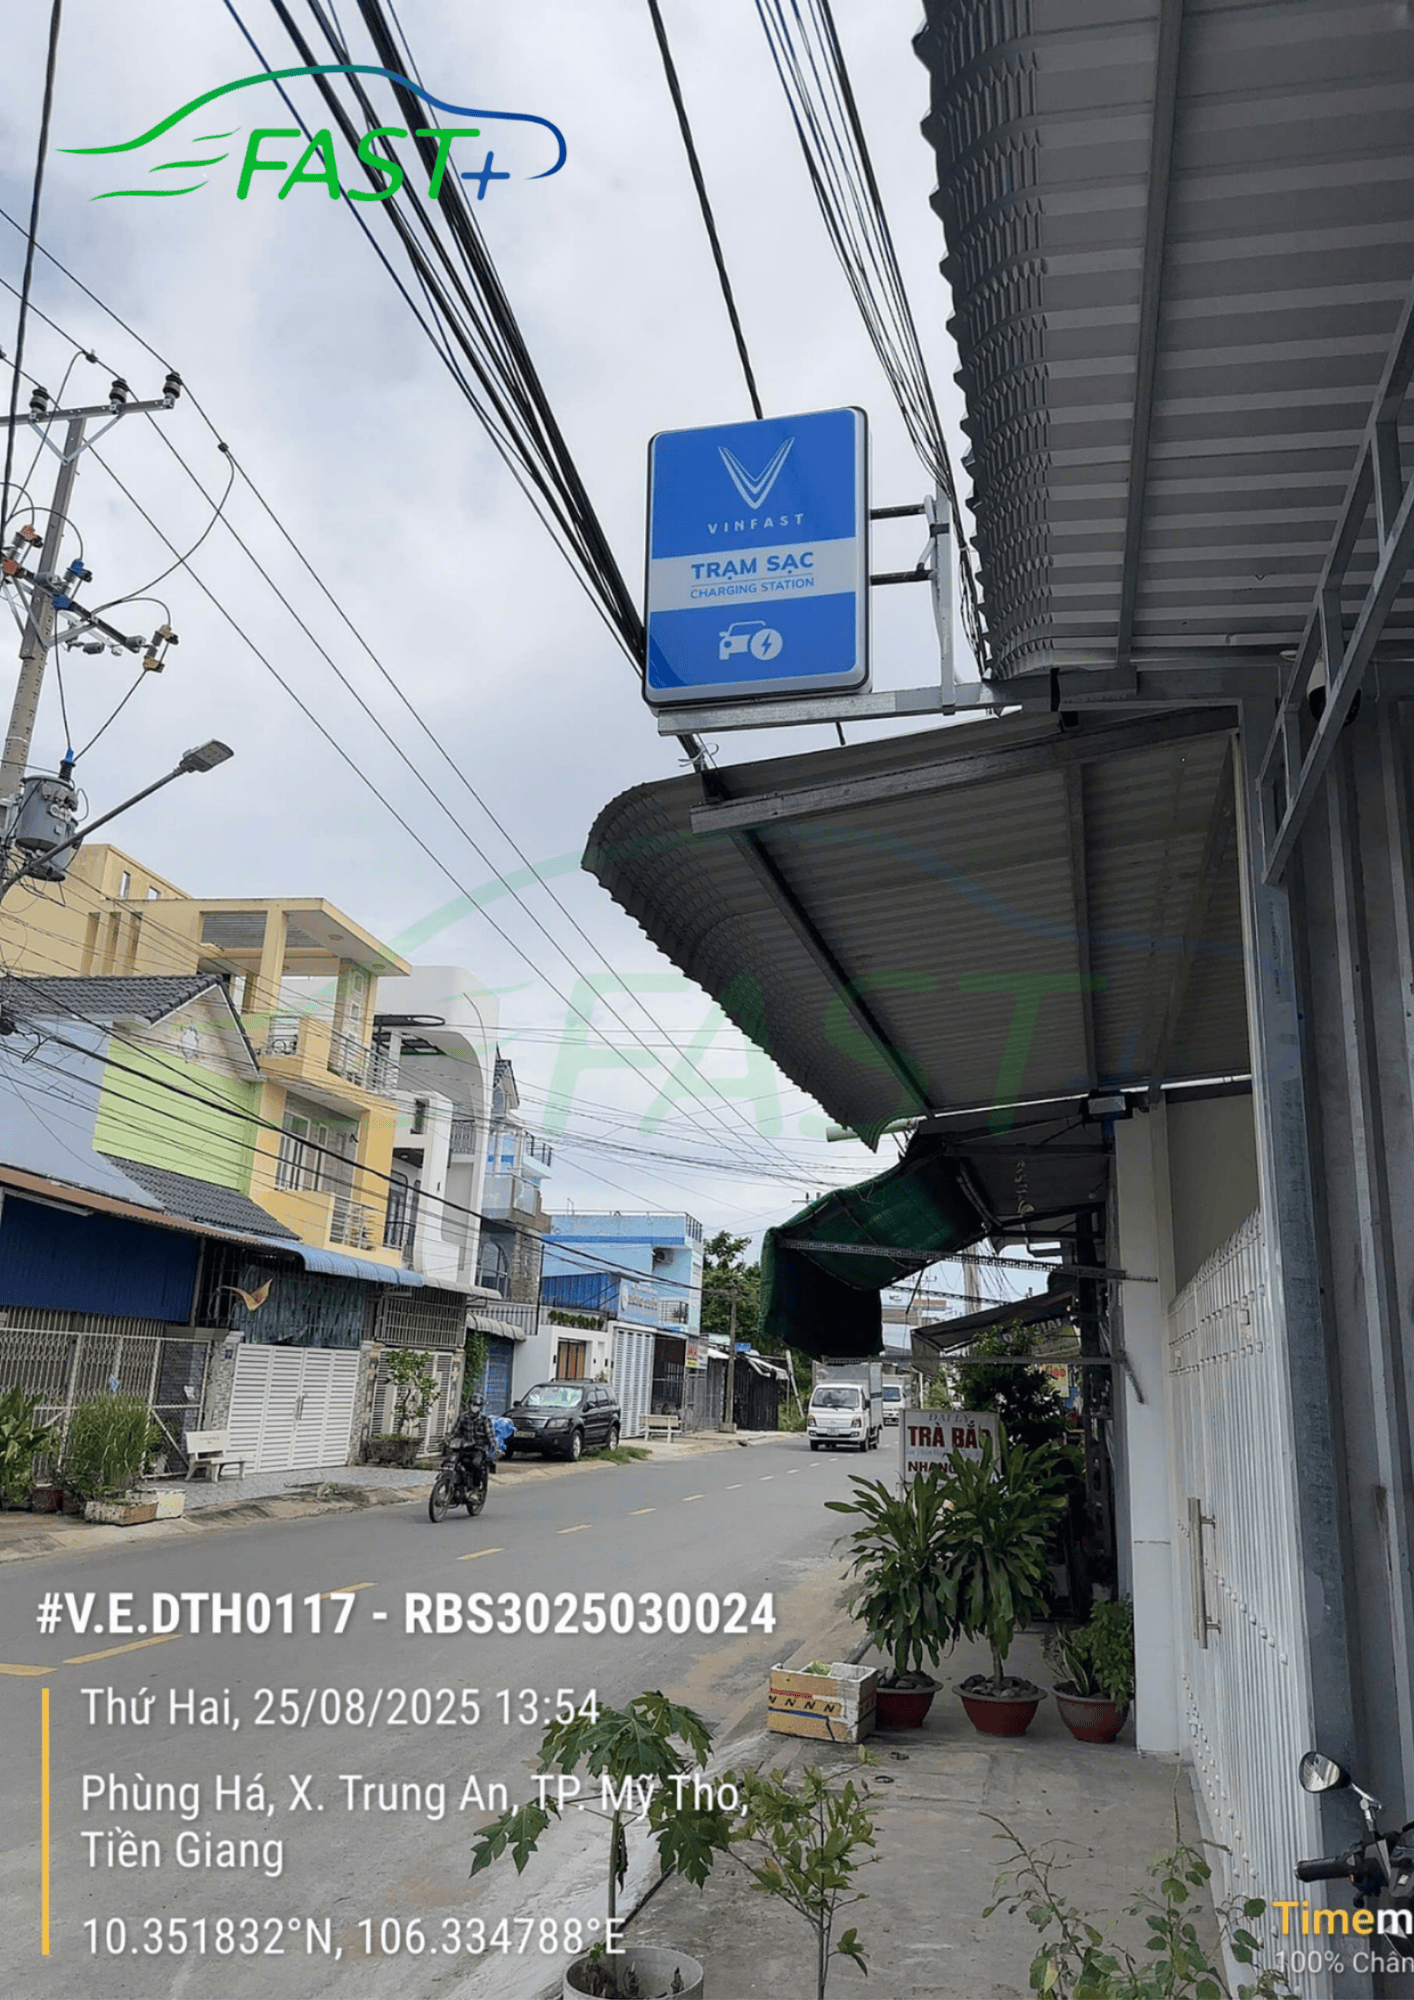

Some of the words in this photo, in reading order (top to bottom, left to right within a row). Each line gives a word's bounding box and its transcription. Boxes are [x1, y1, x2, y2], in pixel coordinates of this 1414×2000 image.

[707, 513, 804, 534] VINFAST
[690, 557, 757, 580] TRẠM
[766, 551, 814, 574] SẠC
[690, 584, 757, 599] CHARGING
[761, 578, 815, 592] STATION
[907, 1421, 945, 1447] TRÀ
